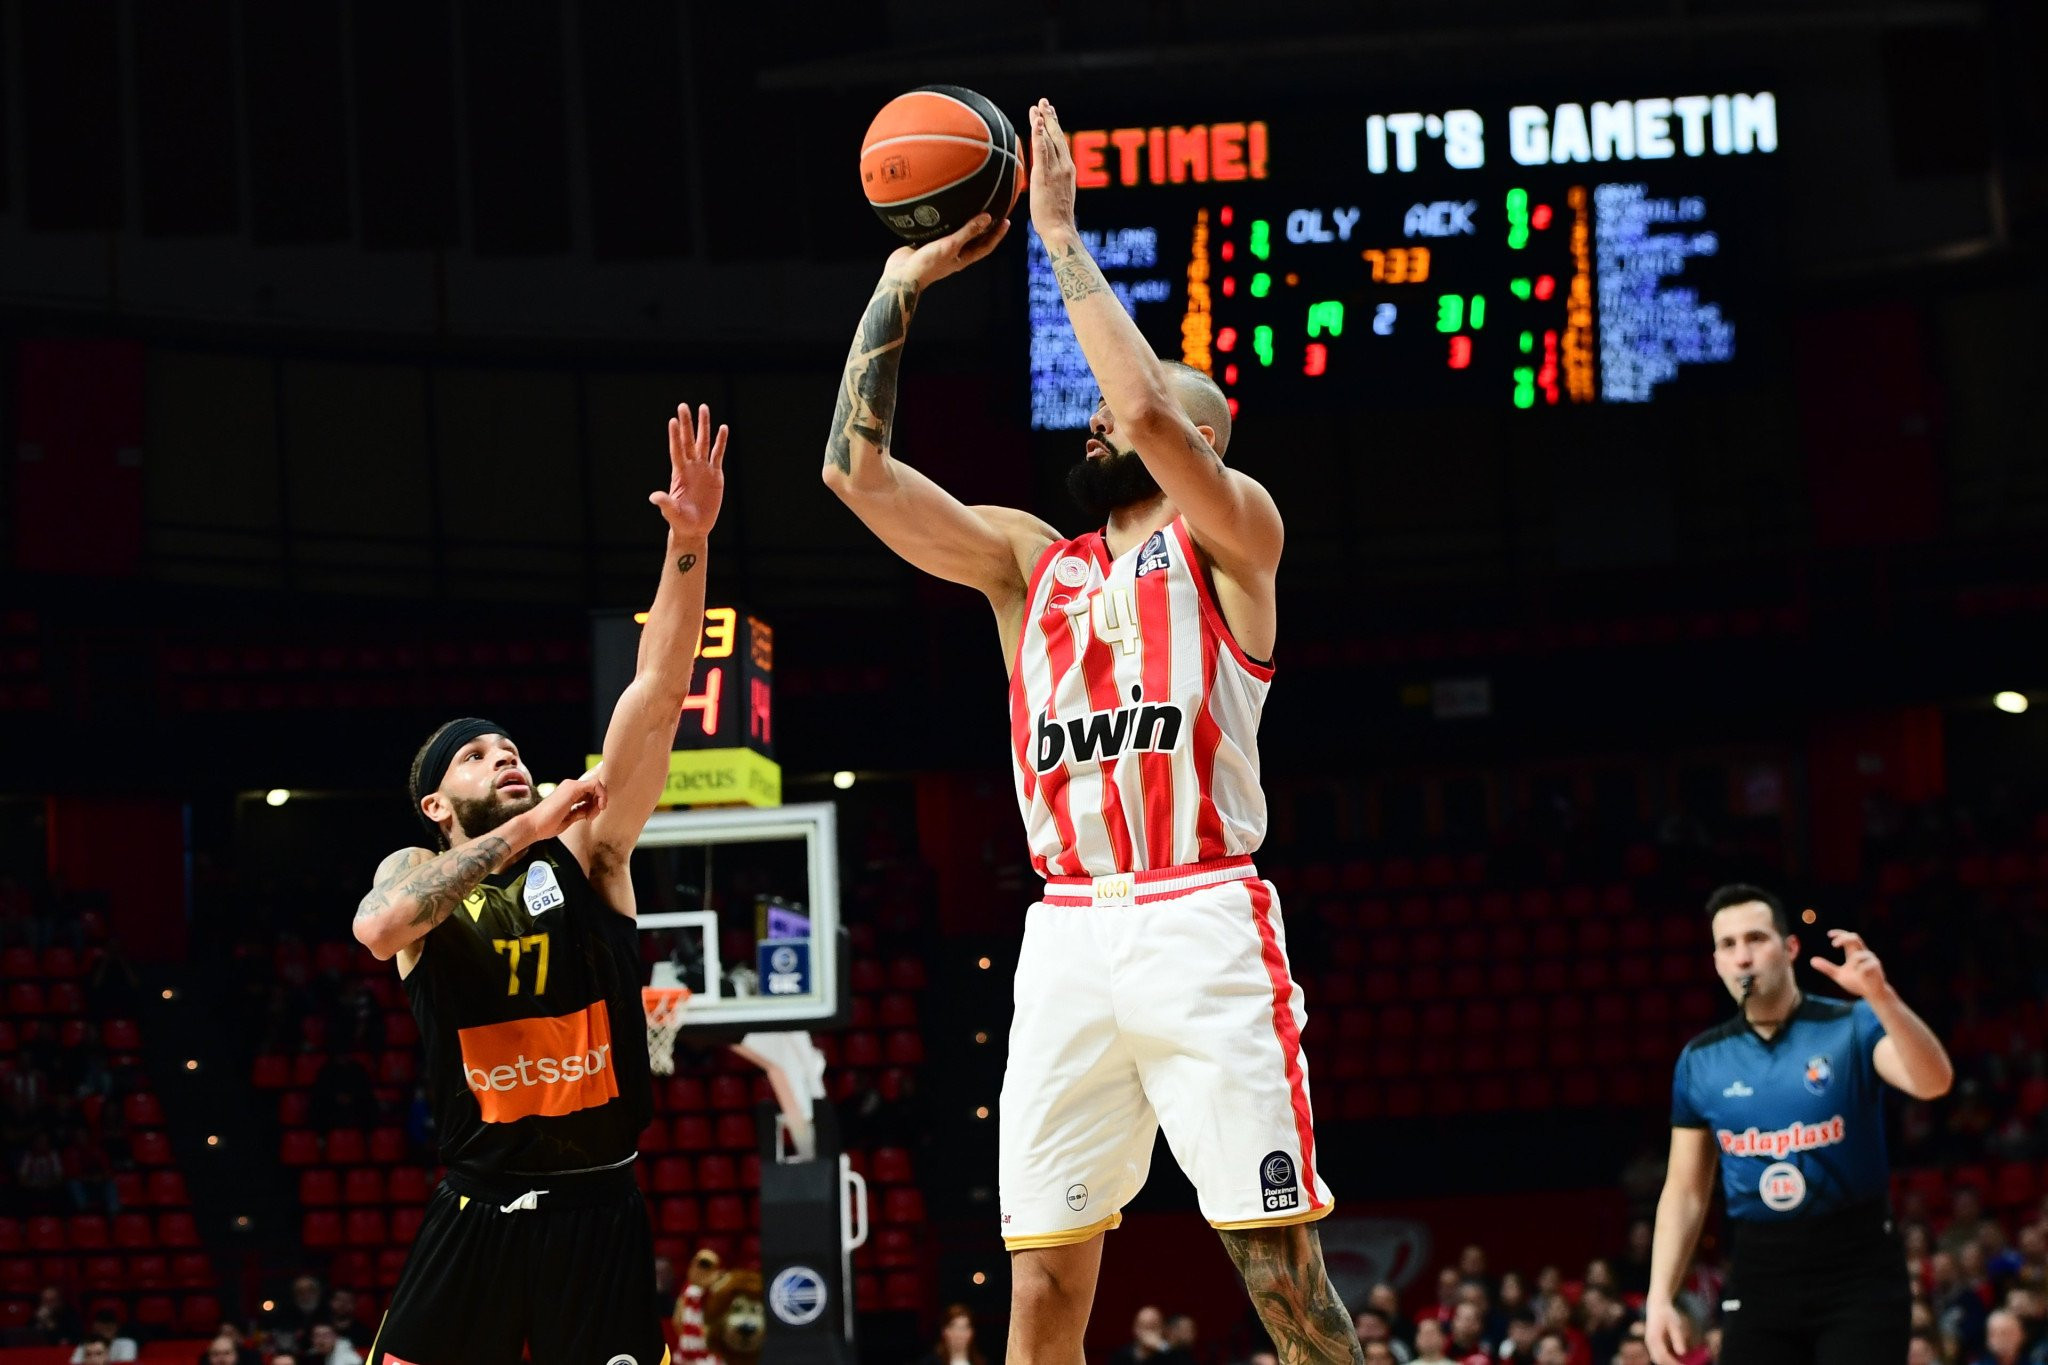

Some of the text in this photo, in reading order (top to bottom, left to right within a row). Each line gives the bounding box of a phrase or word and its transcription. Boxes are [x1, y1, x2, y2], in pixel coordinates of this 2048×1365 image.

[1366, 91, 1778, 174] IT'S GAMETIM
[1068, 121, 1268, 189] ETIME!
[1287, 207, 1361, 244] OLY
[1037, 684, 1183, 773] bwin
[667, 768, 736, 791] raeus
[532, 892, 560, 911] GBL
[492, 932, 549, 997] 77
[1717, 1115, 1845, 1159] Palaplast
[1266, 1193, 1297, 1209] GBL
